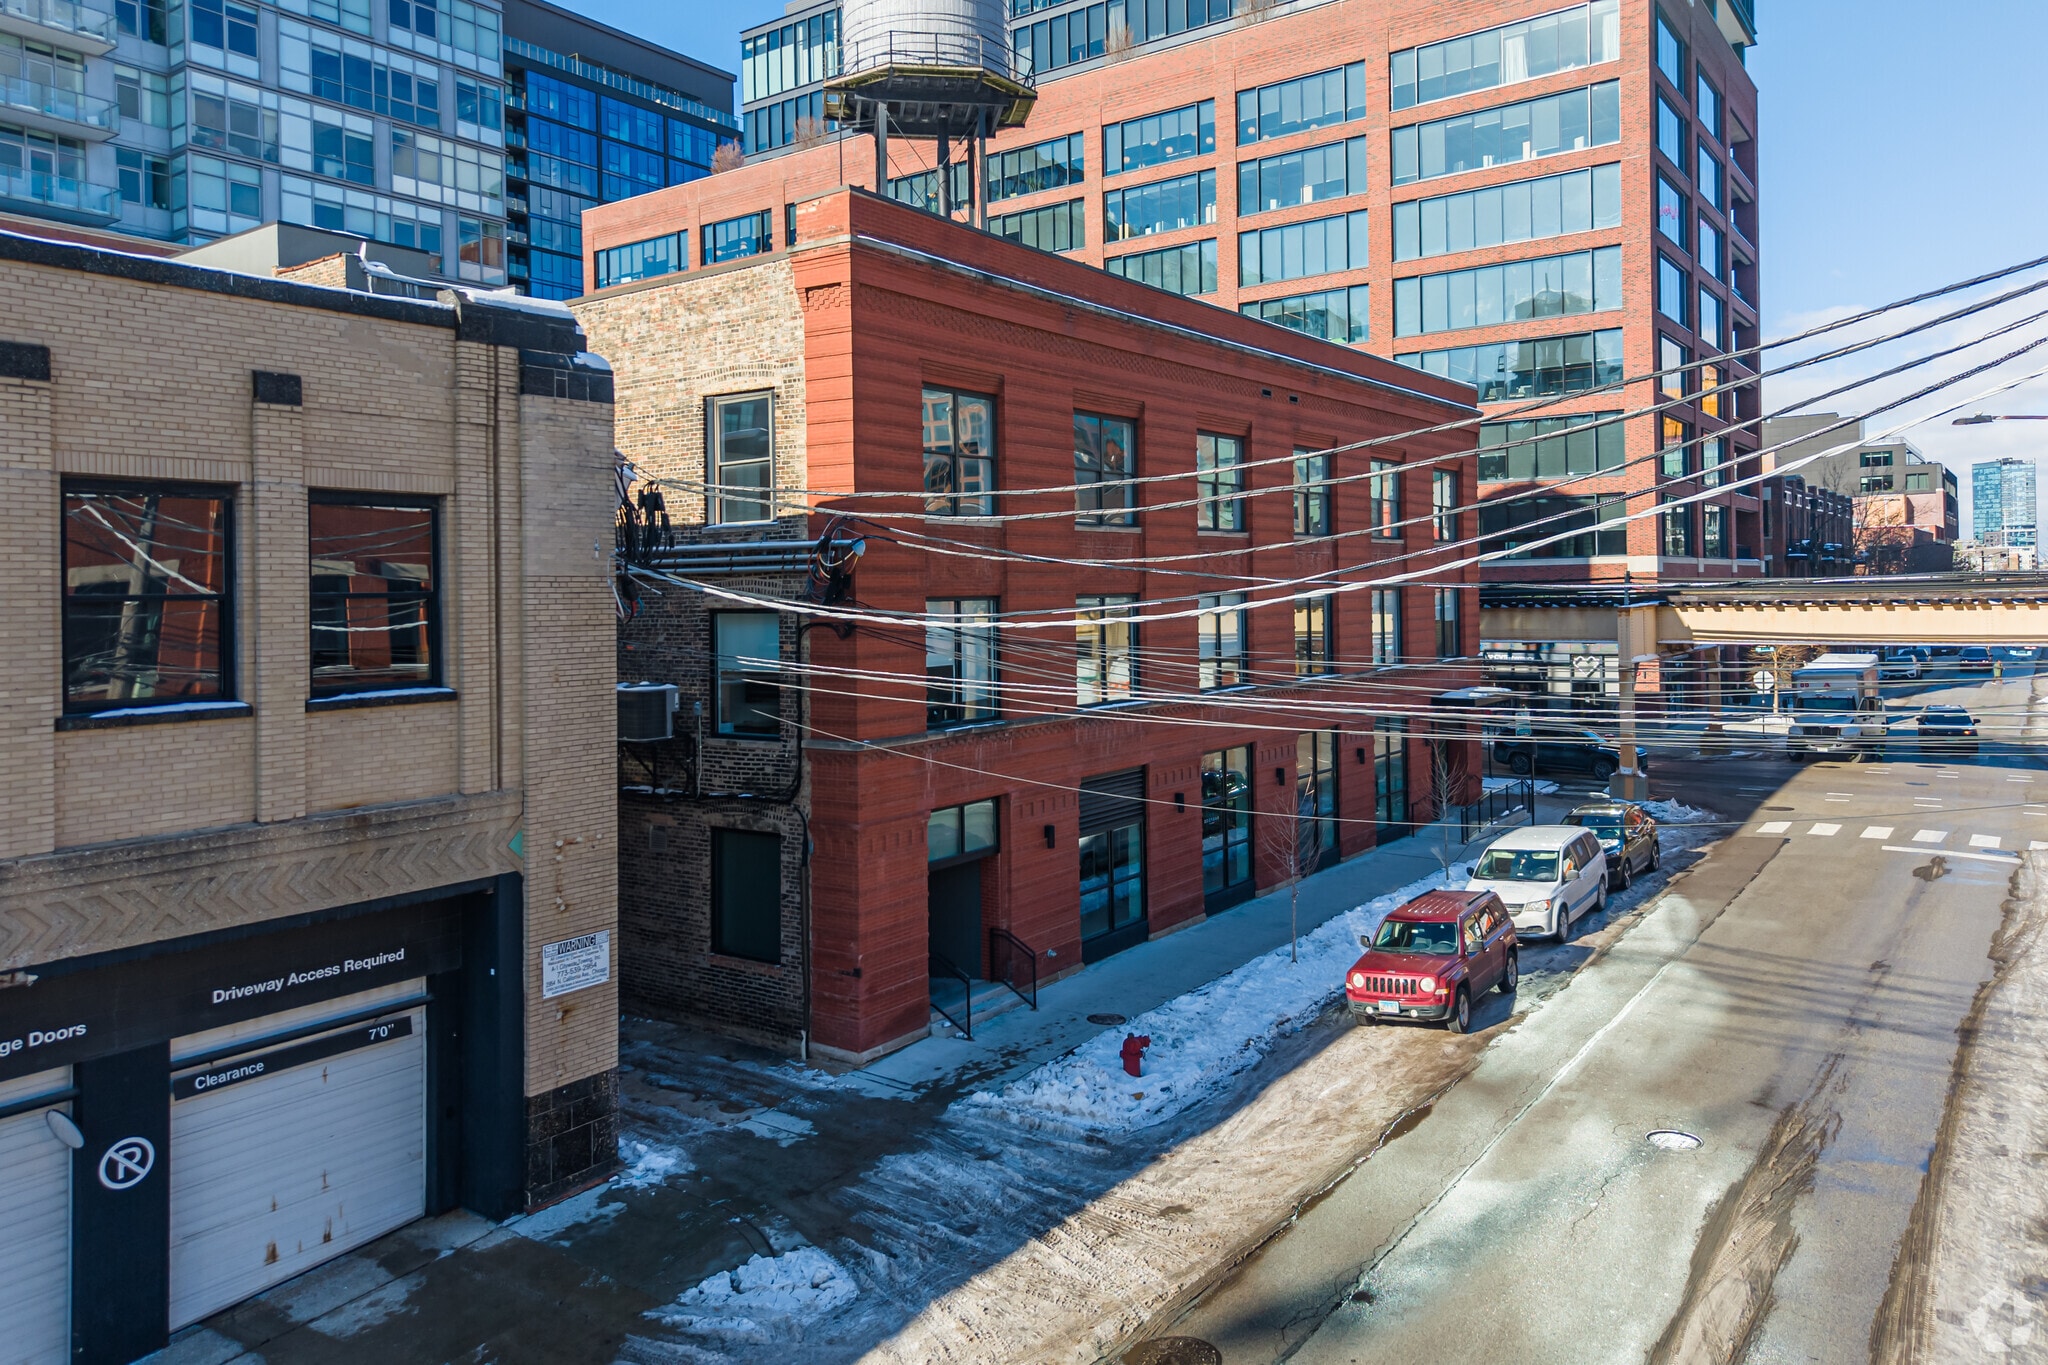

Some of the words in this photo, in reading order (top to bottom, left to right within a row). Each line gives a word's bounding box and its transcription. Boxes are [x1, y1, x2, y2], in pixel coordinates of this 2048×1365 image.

[558, 935, 595, 954] WARNING
[212, 978, 285, 1004] Driveway
[287, 965, 341, 986] Access
[344, 949, 405, 973] Required
[28, 1024, 87, 1047] Doors
[195, 1062, 264, 1089] Clearance
